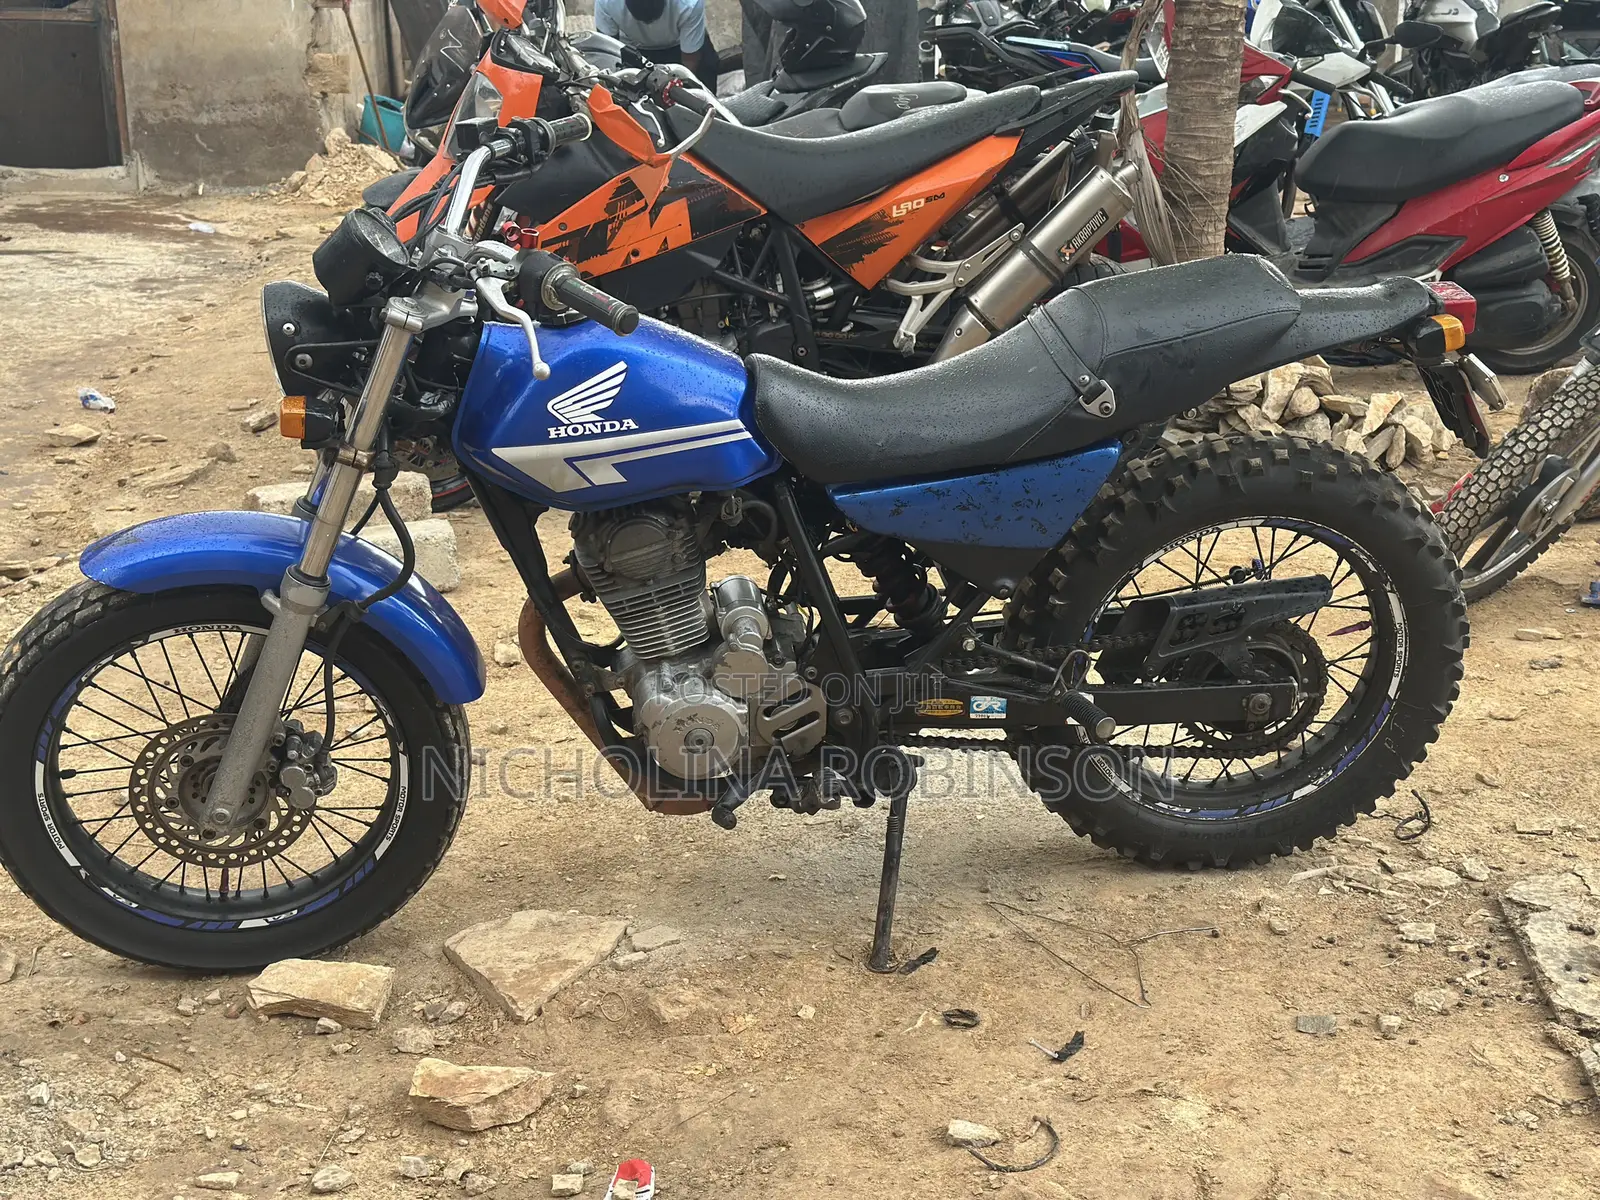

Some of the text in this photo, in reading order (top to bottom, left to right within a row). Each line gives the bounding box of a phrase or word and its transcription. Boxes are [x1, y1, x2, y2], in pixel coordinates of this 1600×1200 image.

[547, 418, 639, 439] HONDA
[1163, 526, 1221, 553] HONDA
[173, 624, 242, 634] HONDA
[1393, 622, 1404, 678] MOTOR SPORTS
[1096, 756, 1116, 780] MOTOR
[37, 793, 65, 850] MOTOR SPORTS
[385, 785, 407, 842] MOTOR SPORTS
